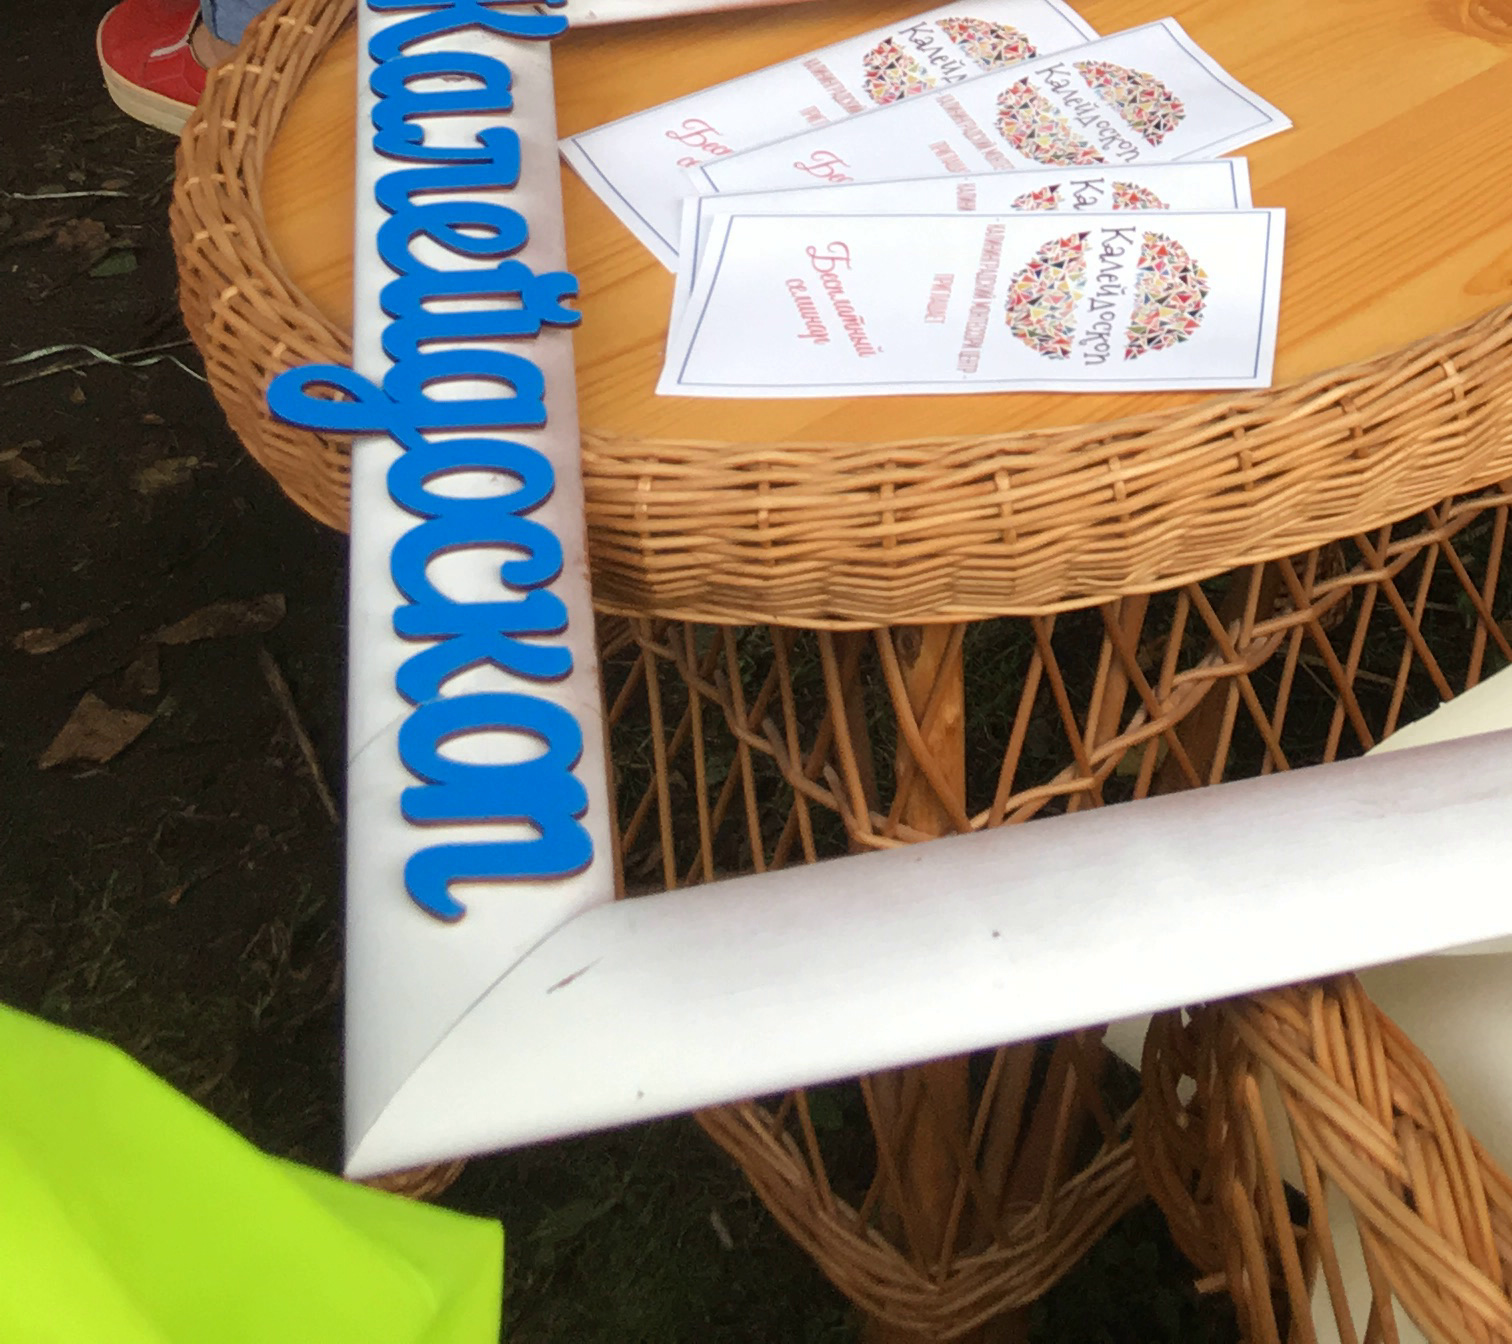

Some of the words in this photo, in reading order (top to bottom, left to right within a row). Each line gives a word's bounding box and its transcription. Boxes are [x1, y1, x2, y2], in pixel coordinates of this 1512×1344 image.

[899, 21, 968, 84] Калейд
[1035, 62, 1140, 162] Калейдоскоп
[785, 278, 831, 345] семинар
[805, 241, 884, 358] Бесплатный
[1083, 225, 1136, 366] Калейдоскоп
